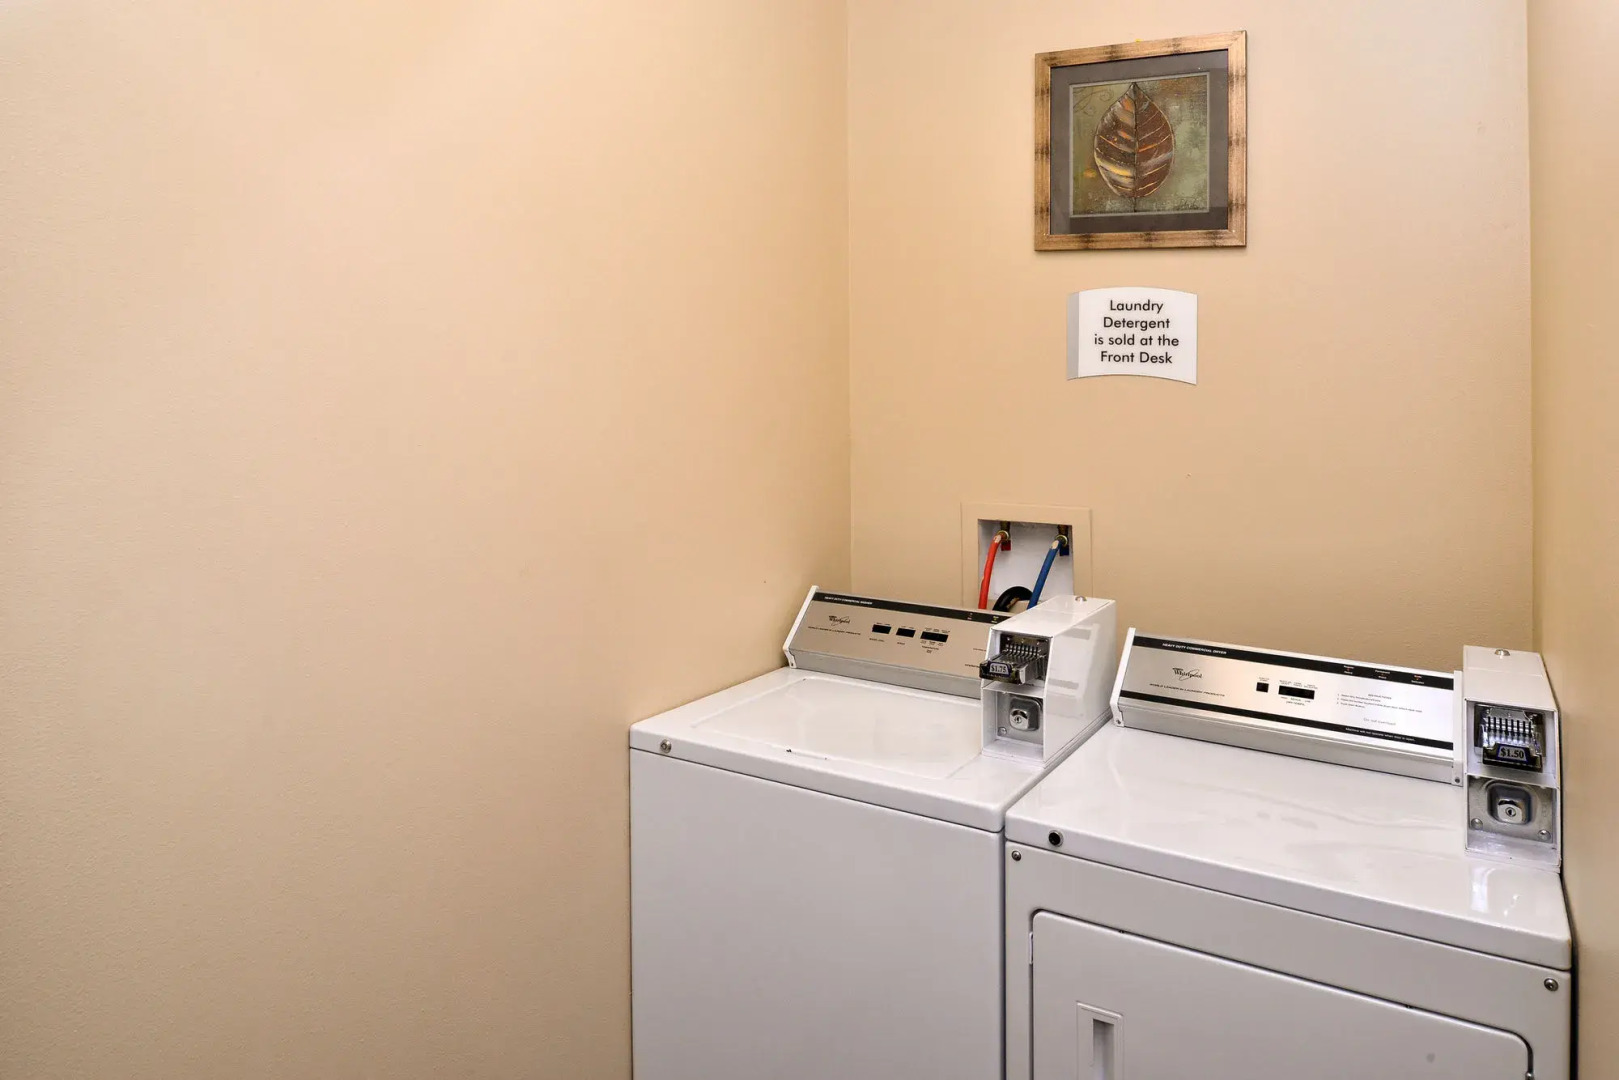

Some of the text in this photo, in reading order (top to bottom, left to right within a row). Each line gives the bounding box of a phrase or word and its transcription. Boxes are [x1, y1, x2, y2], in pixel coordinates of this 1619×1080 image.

[1110, 299, 1164, 314] Laundry
[1103, 316, 1170, 331] Detergent
[1094, 333, 1180, 347] is sold at the
[1100, 350, 1173, 364] Front Desk
[990, 665, 1006, 673] $1.75
[1172, 667, 1203, 681] Whirlpool
[1500, 747, 1524, 759] $1.50
